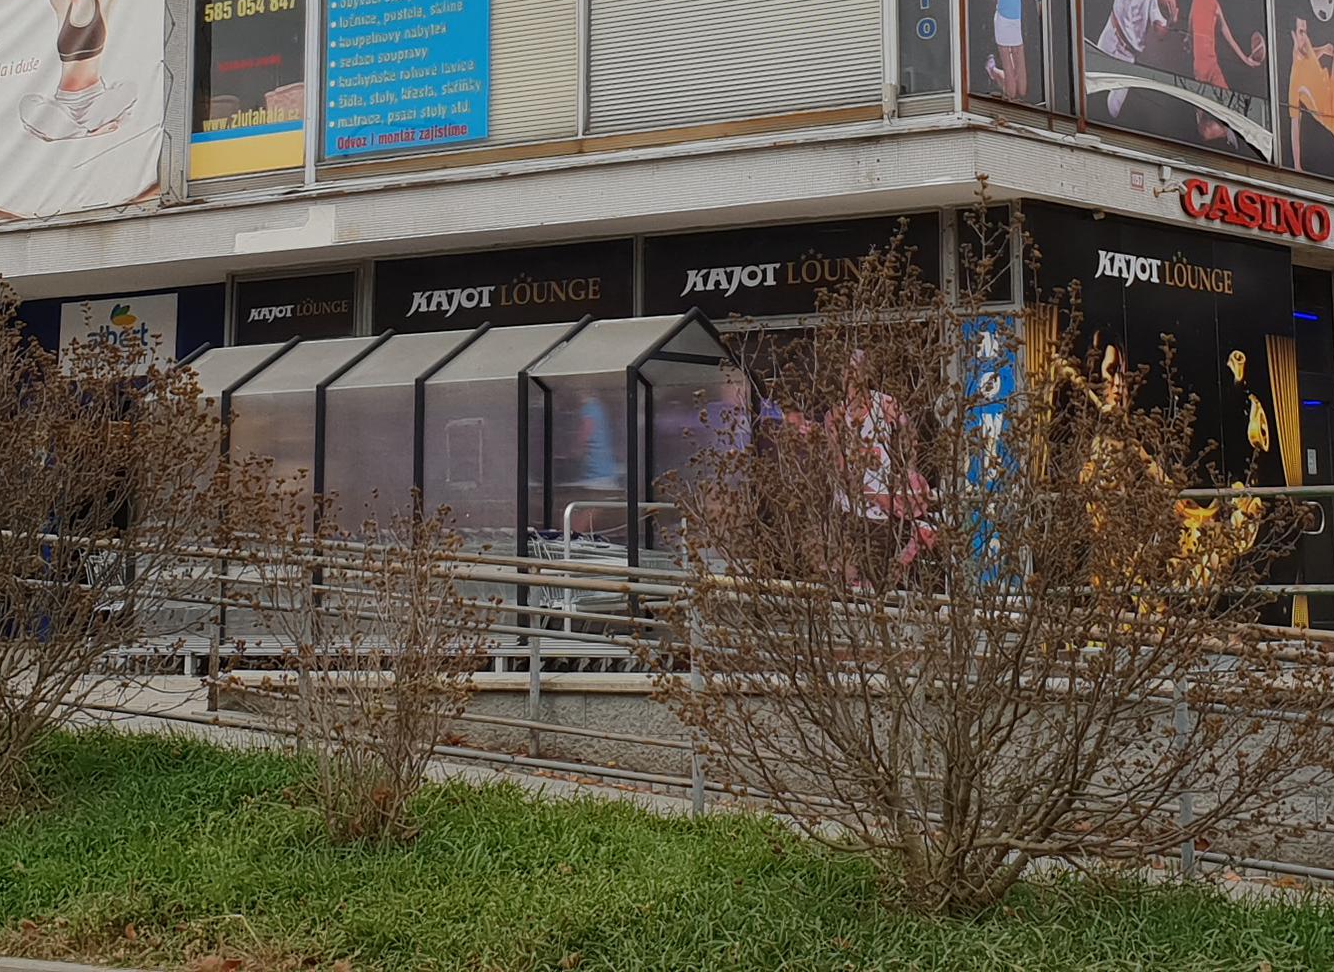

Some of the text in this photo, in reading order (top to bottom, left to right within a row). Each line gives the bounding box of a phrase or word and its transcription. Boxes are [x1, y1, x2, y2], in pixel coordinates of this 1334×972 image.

[204, 0, 233, 23] 585
[15, 58, 40, 76] duše
[337, 135, 367, 151] Odvoz
[1180, 178, 1332, 243] CASINO
[680, 257, 865, 298] KAJOT LOUN
[1094, 249, 1234, 295] KAJOT LOUNGE
[247, 299, 349, 324] KAJOT LOUNGE
[405, 277, 602, 318] KAJOT LOUNGE
